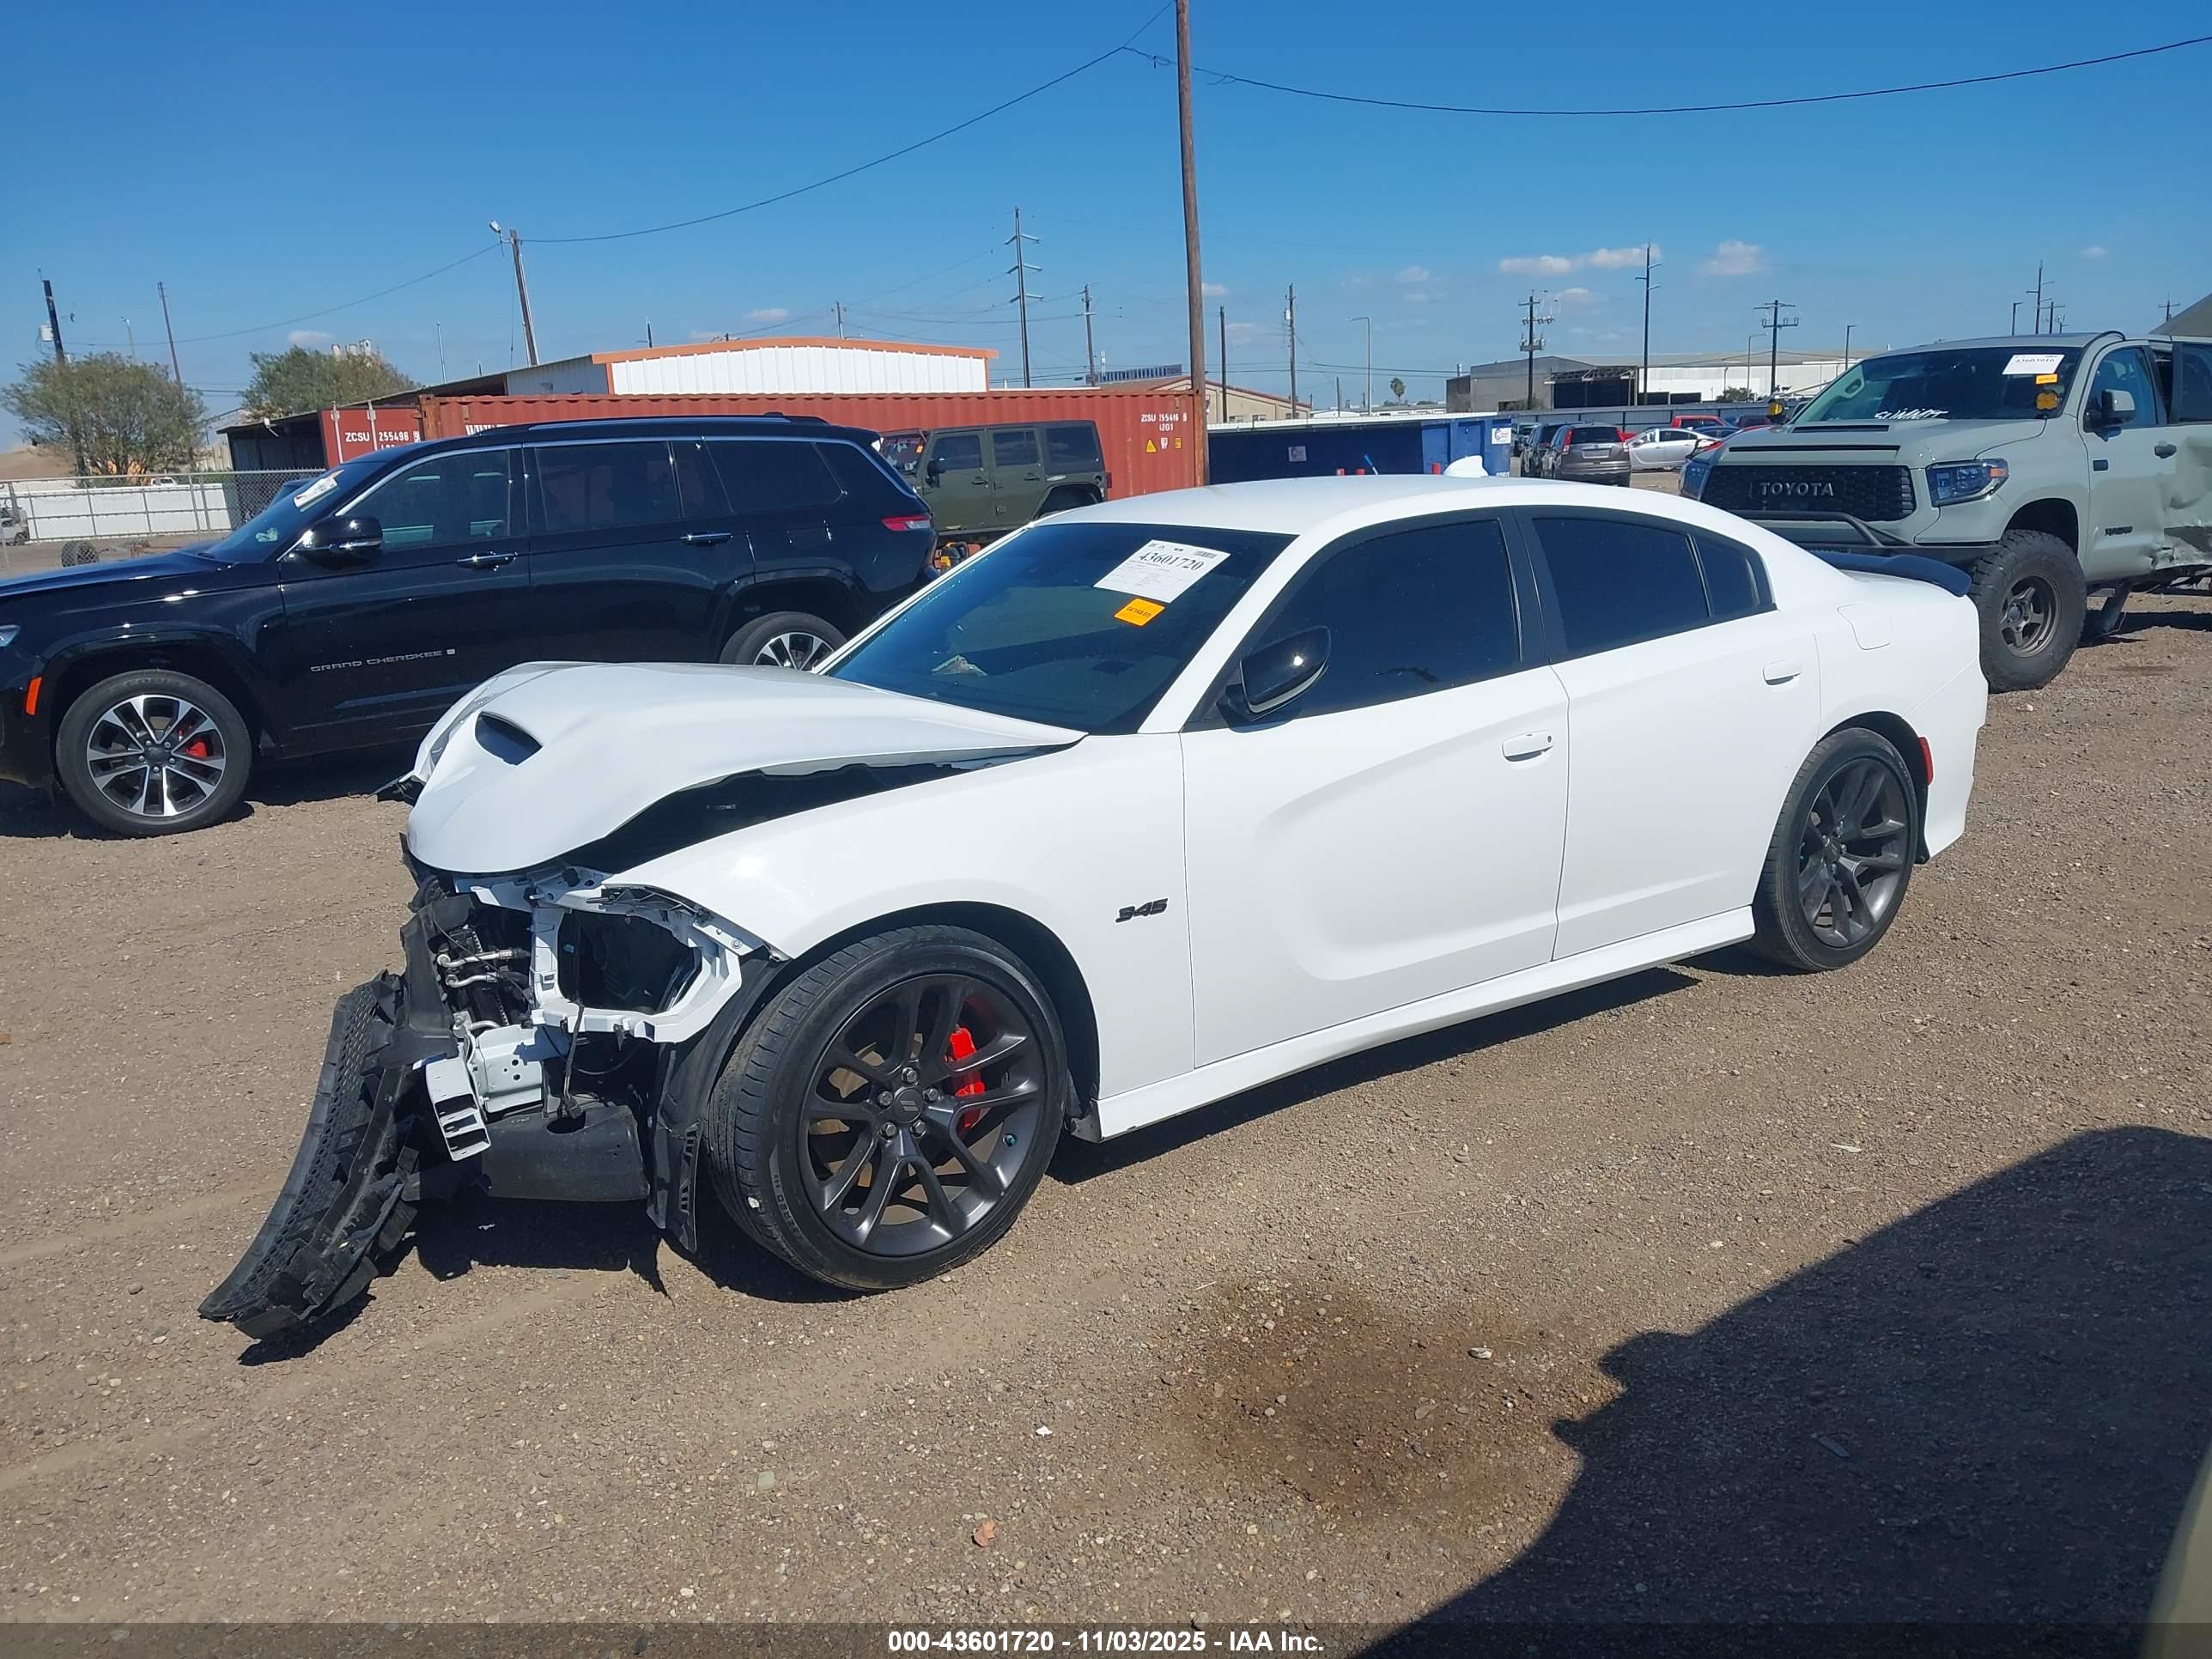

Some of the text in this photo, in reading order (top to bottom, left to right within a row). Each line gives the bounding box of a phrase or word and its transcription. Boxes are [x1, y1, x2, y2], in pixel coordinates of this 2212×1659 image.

[344, 432, 370, 442] ZCSU
[378, 431, 410, 441] 255496
[1759, 482, 1834, 496] TOYOTA
[1139, 551, 1205, 571] 43601720
[310, 660, 362, 672] GRAND
[366, 650, 443, 665] CHEROKEE
[1115, 898, 1169, 923] 345
